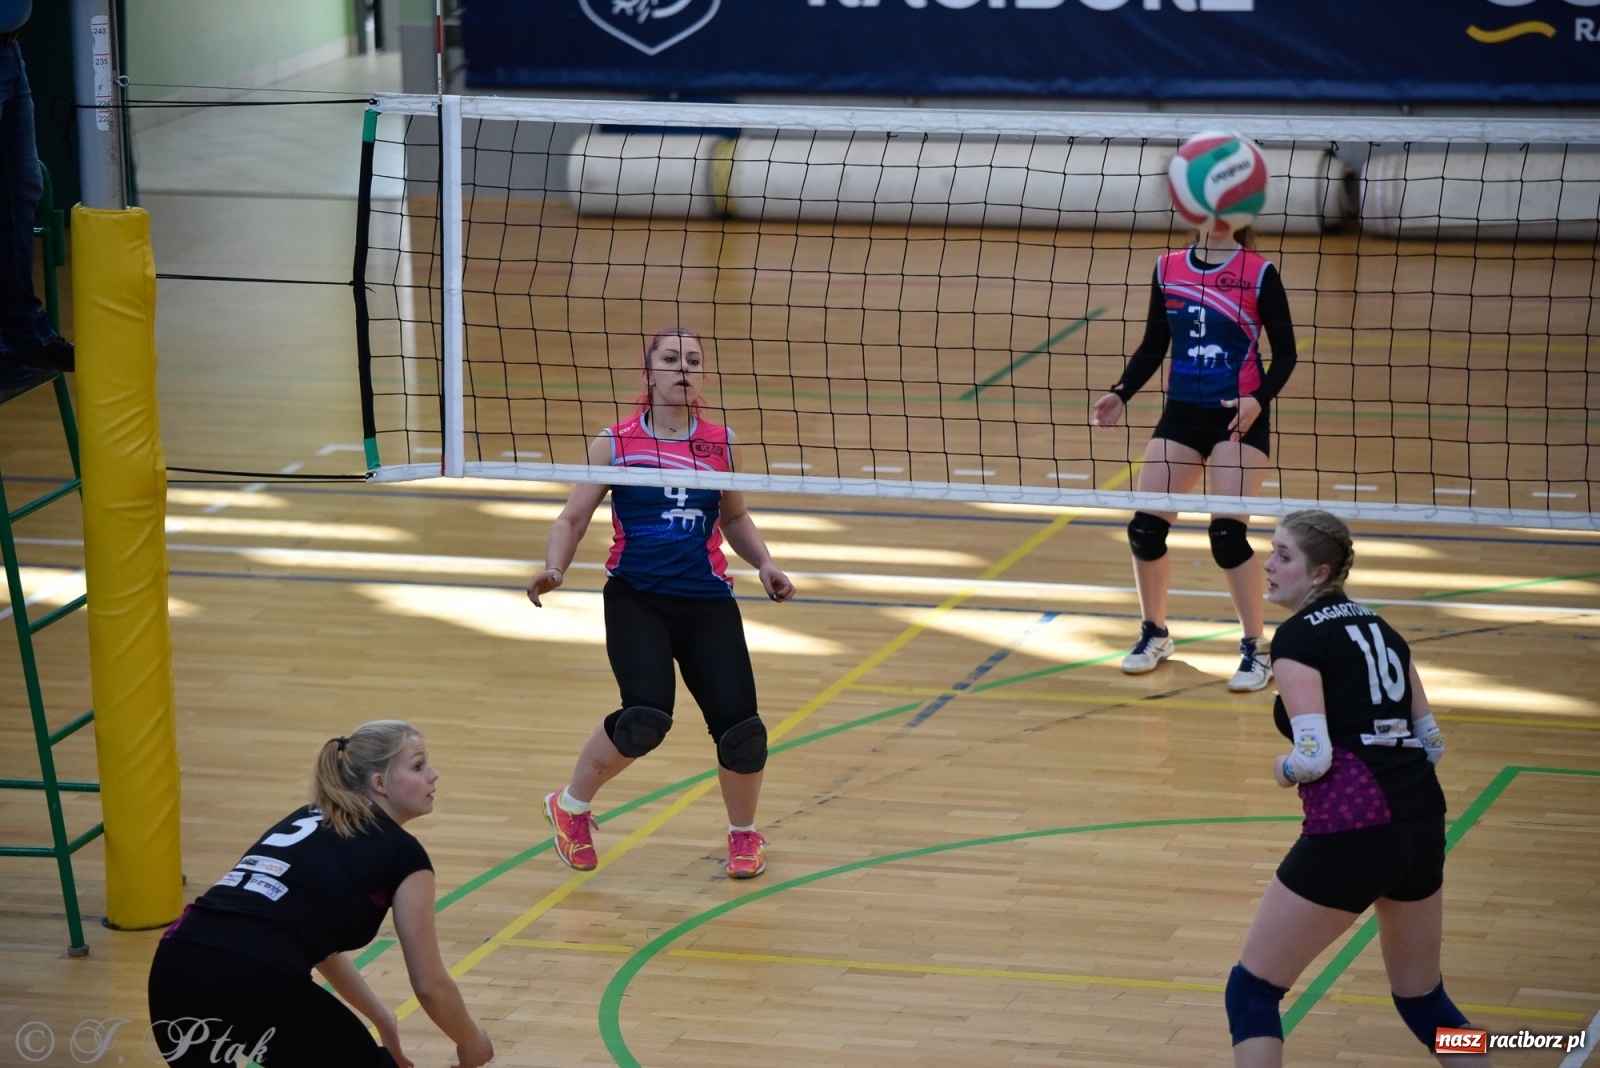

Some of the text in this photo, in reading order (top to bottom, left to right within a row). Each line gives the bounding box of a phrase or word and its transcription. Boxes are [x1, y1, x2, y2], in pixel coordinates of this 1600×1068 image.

[95, 58, 109, 66] 235
[1187, 305, 1207, 338] 3
[663, 486, 689, 507] 4
[1344, 622, 1406, 705] 16
